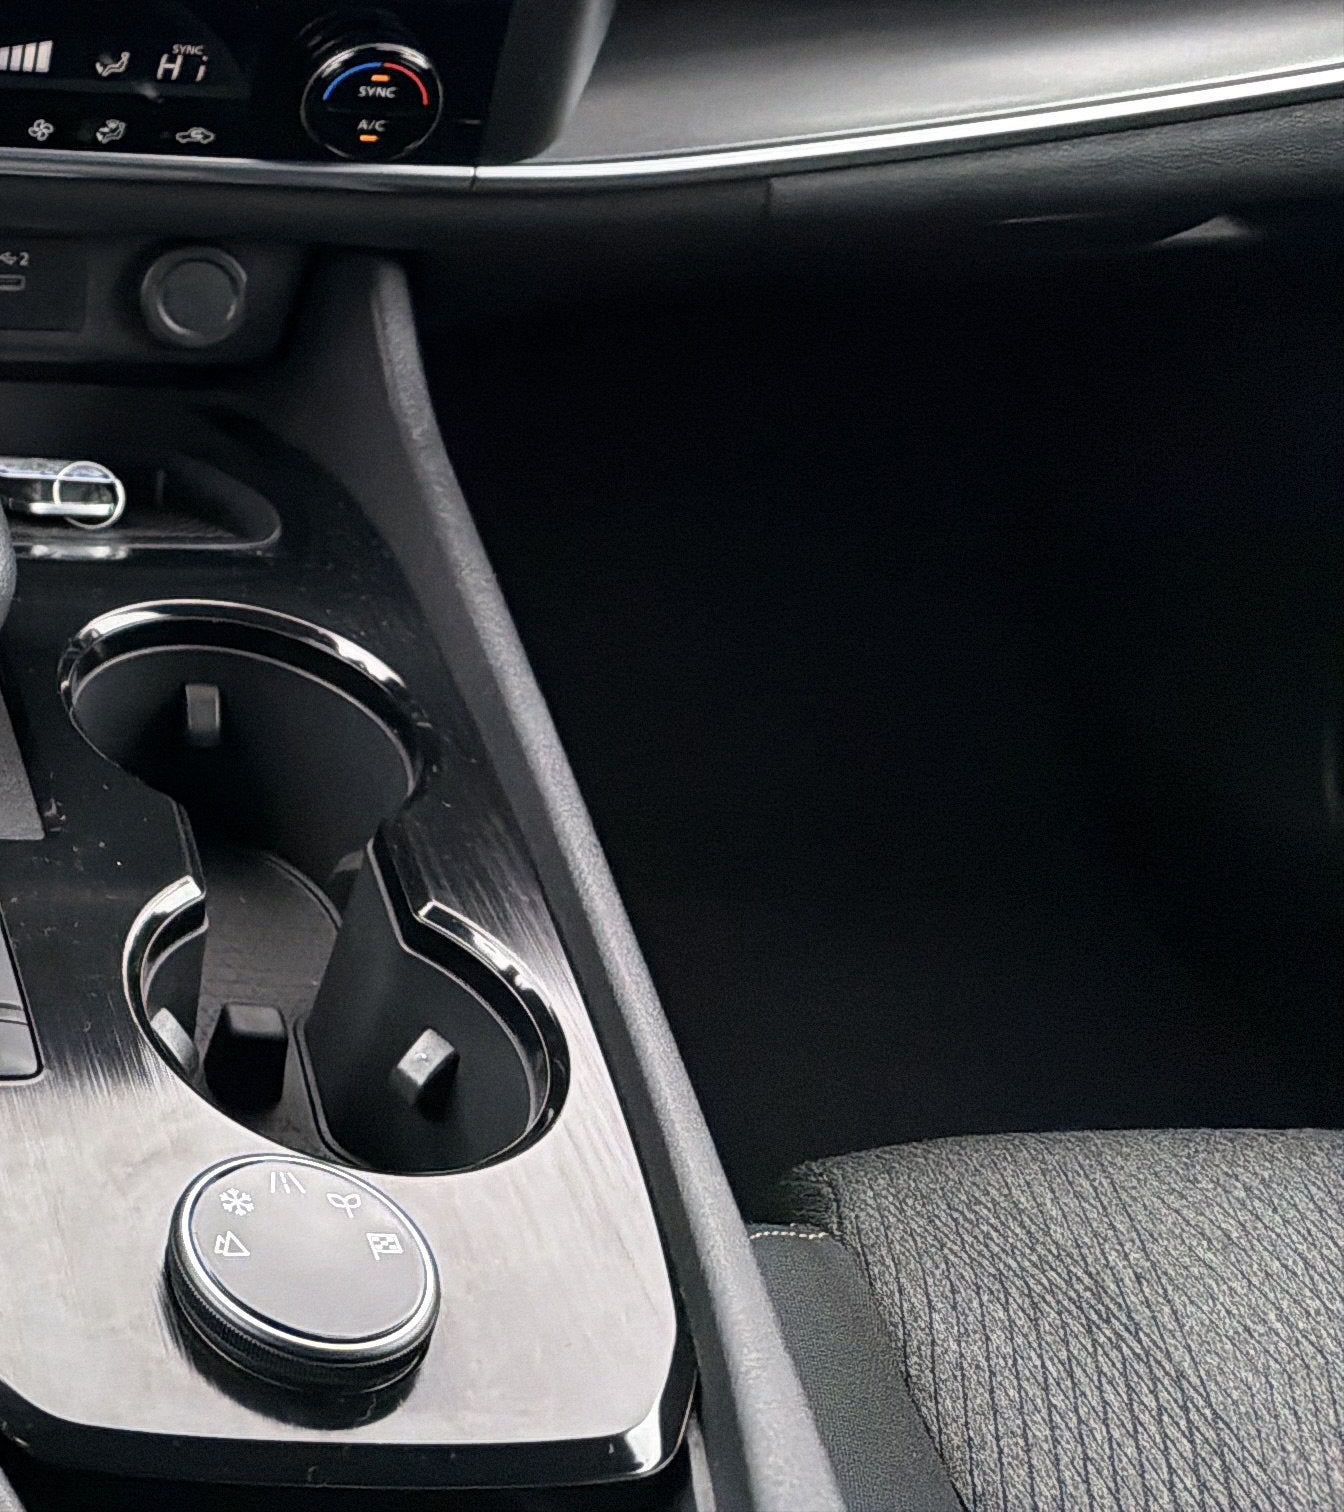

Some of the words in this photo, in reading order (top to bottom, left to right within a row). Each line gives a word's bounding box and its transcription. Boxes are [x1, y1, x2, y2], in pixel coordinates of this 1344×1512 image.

[172, 43, 204, 55] SYNC
[358, 86, 397, 99] SYNC
[357, 118, 387, 132] A/C
[18, 251, 30, 265] 2
